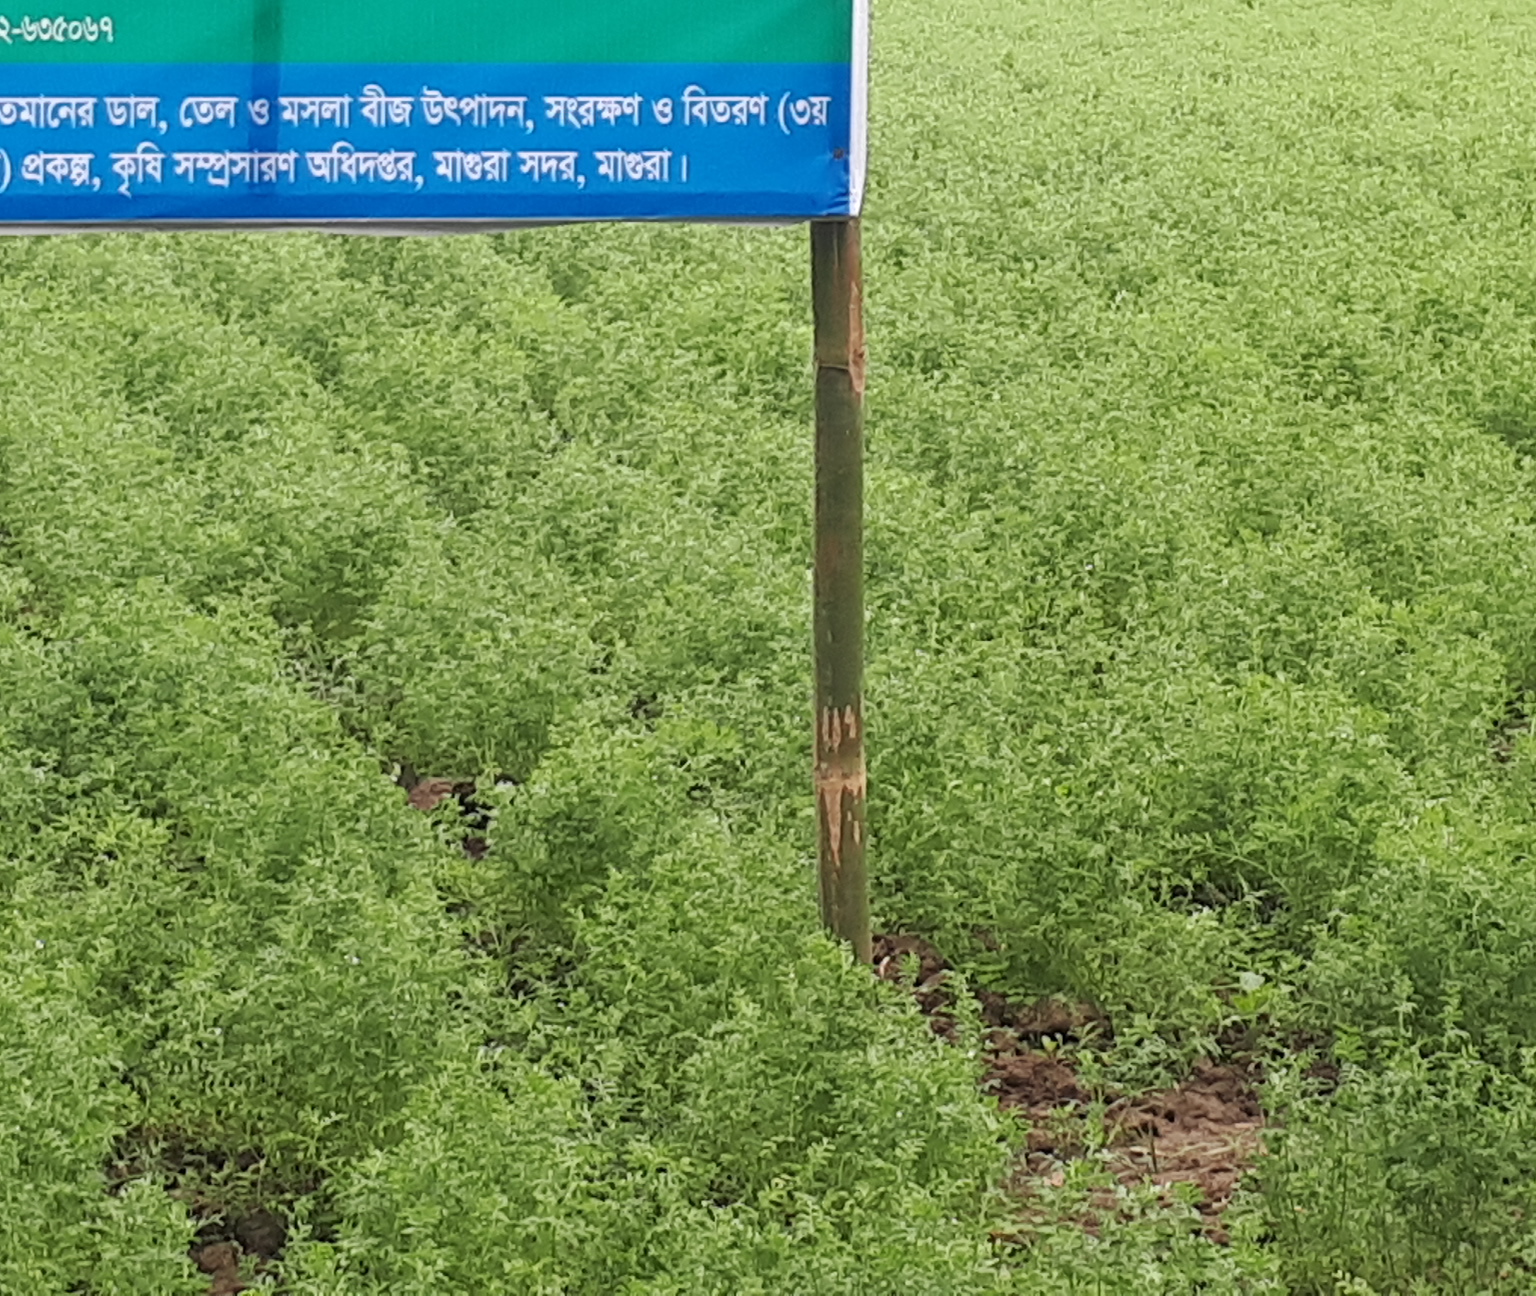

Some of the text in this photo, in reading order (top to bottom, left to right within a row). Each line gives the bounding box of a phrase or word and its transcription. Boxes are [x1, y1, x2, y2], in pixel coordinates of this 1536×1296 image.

[103, 95, 168, 134] ডাল,
[179, 96, 240, 128] তেল
[247, 99, 269, 125] ও
[277, 95, 354, 127] মসলা
[358, 83, 416, 127] বীজ
[419, 86, 534, 132] উৎপাদন,
[543, 93, 644, 129] সংরক্ষণ
[652, 97, 673, 125] ও
[680, 84, 770, 125] বিতরণ
[777, 93, 832, 134] (৩য়
[21, 151, 101, 191] প্রকল্প,
[109, 141, 167, 196] কৃষি
[171, 149, 300, 188] সম্প্রসারণ
[304, 140, 424, 189] অধিদপ্তর,
[432, 150, 512, 182] মাগুরা
[516, 150, 586, 188] সদর,
[593, 149, 673, 182] মাগুরা
